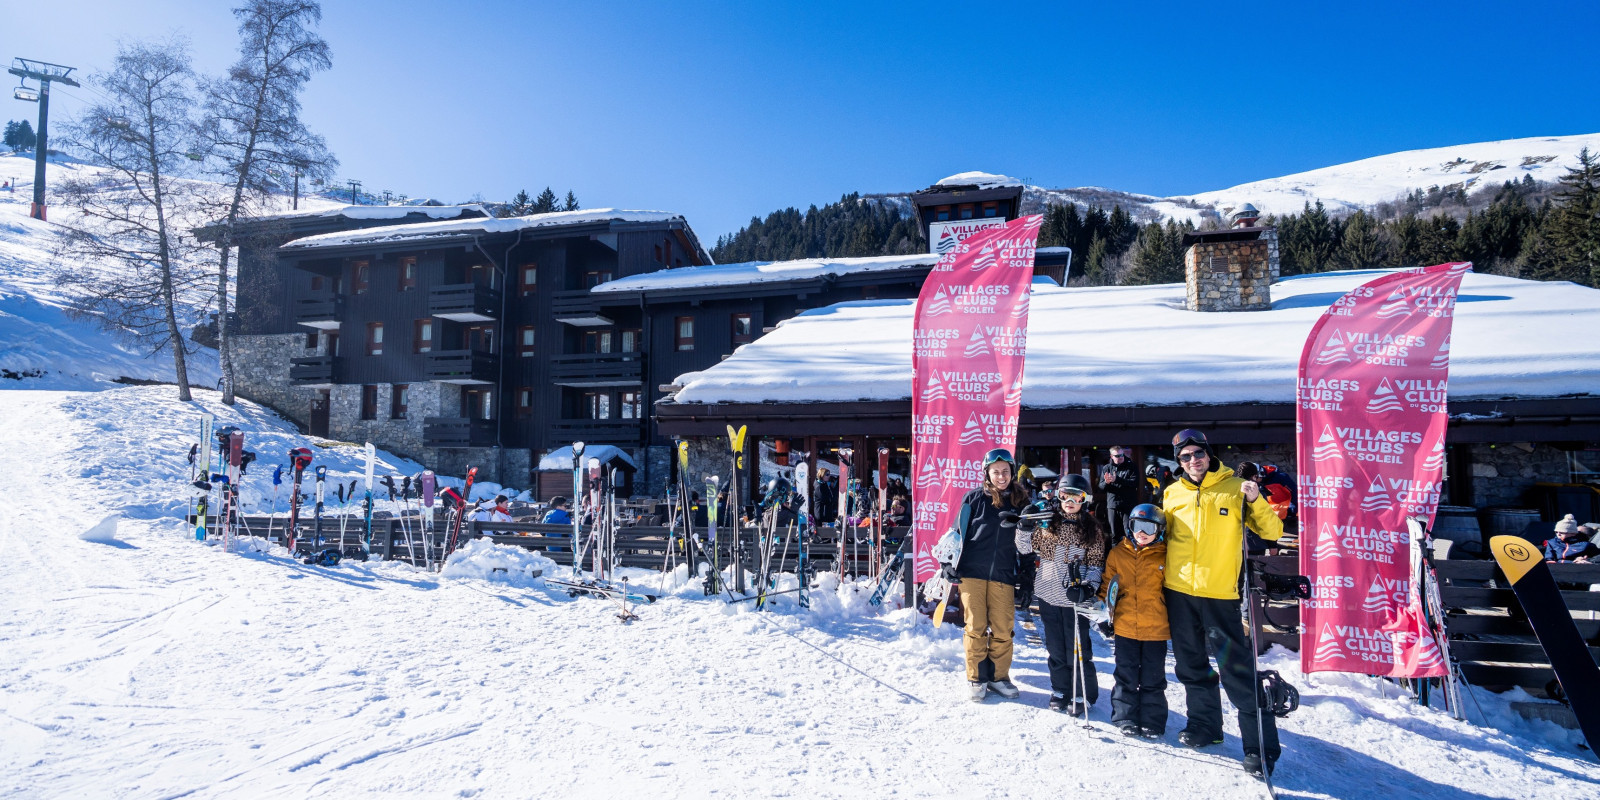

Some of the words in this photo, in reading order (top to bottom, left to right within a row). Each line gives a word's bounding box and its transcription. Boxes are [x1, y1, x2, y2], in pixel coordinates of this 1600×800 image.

[948, 285, 1010, 295] VILLAGES
[954, 295, 997, 305] CLUBS
[963, 306, 996, 314] SOLEIL
[1346, 331, 1426, 348] VILLAGES
[1352, 343, 1409, 358] CLUBS
[1365, 356, 1408, 367] SOLEIL
[942, 371, 1003, 383] VILLAGES
[948, 382, 990, 393] CLUBS
[957, 393, 990, 402] SOLEIL
[1302, 401, 1343, 412] SOLEIL
[1335, 426, 1423, 444] VILLAGES
[1343, 439, 1405, 455] CLUBS
[1357, 452, 1404, 465] SOLEIL
[1332, 524, 1410, 545] VILLAGES
[1341, 537, 1396, 555] CLUBS
[1356, 551, 1395, 565] SOLEIL
[1304, 600, 1340, 609] SOLEIL
[1335, 624, 1420, 645] VILLAGES
[1345, 639, 1405, 656] CLUBS
[1361, 652, 1406, 667] SOLEIL
